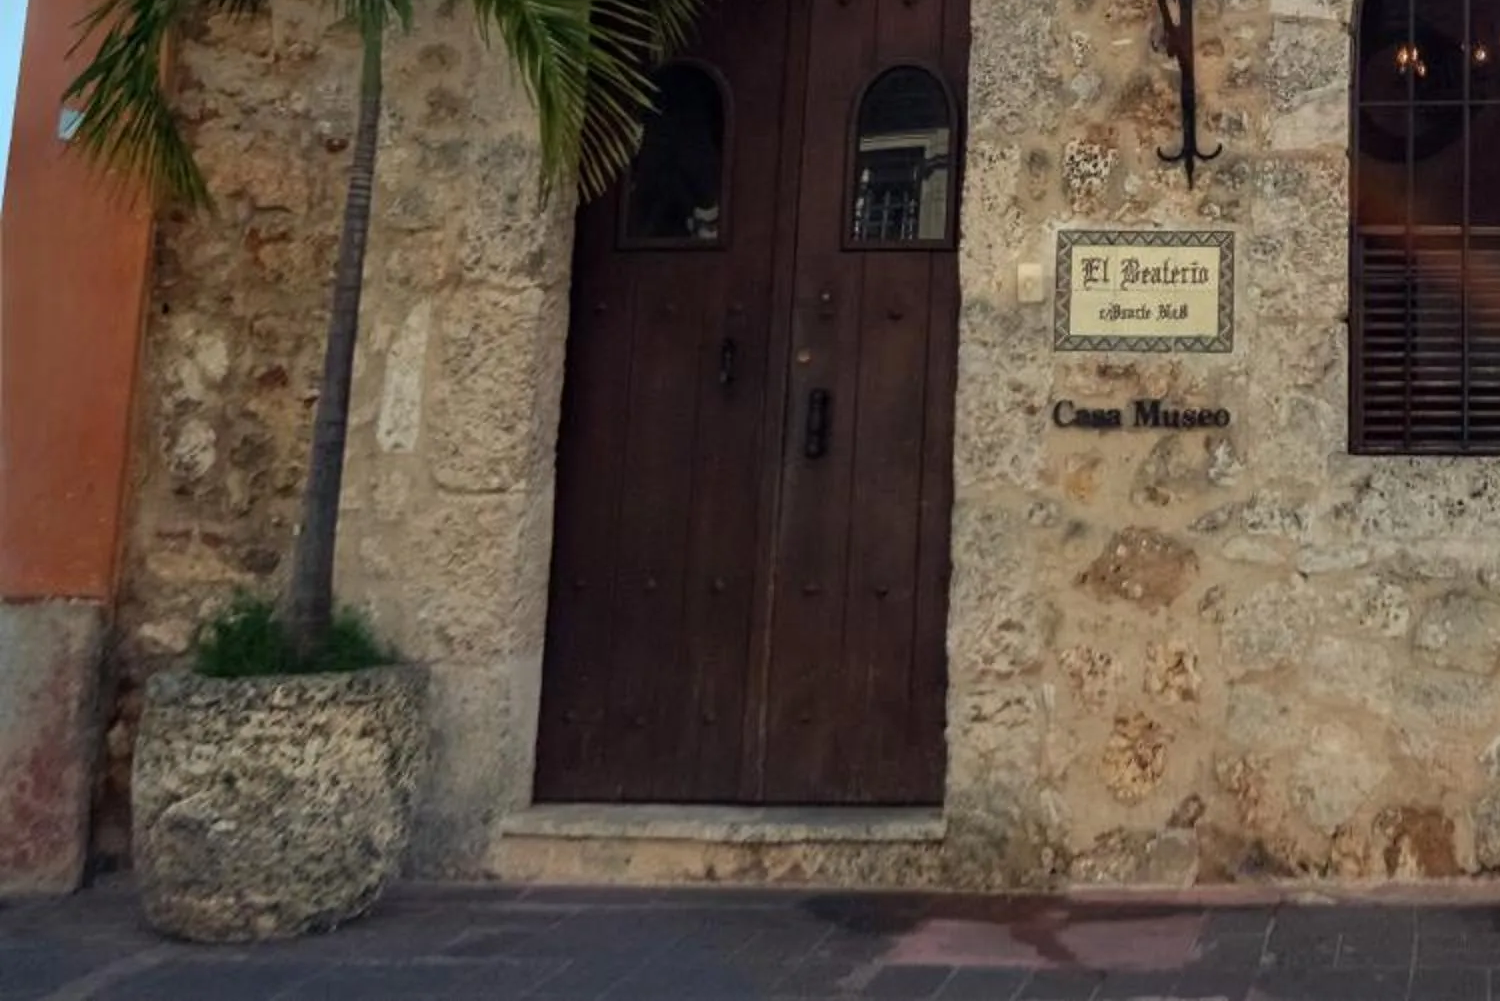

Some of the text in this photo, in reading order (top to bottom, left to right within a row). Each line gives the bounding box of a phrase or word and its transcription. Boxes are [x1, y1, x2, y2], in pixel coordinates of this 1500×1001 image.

[1081, 256, 1210, 291] El Beaterio
[1053, 401, 1231, 430] Casa Museo
